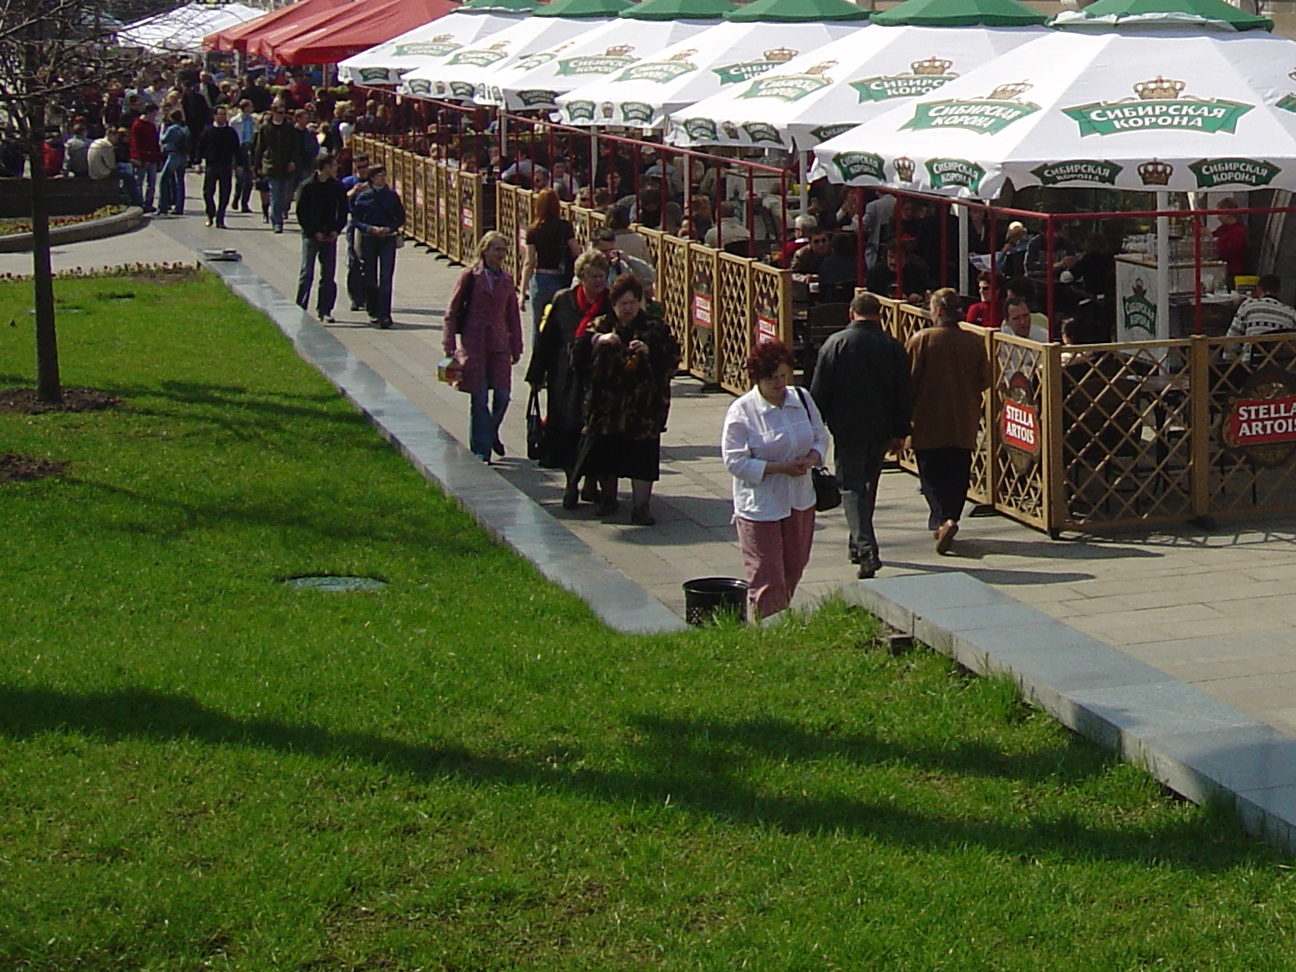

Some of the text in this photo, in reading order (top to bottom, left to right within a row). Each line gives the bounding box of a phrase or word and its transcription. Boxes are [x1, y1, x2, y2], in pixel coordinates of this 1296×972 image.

[870, 79, 951, 91] СИБИРС
[1089, 105, 1226, 122] СИБИРСКАЯ
[1113, 116, 1203, 129] КОРОНА
[933, 161, 979, 180] СИБИРСКАЯ
[1043, 164, 1111, 178] СИБИРСКАЯ
[1202, 162, 1268, 177] СИБИРСКАЯ
[1212, 172, 1256, 183] КОРОНА
[1005, 405, 1034, 428] STELLA
[1005, 421, 1035, 445] ARTOIS
